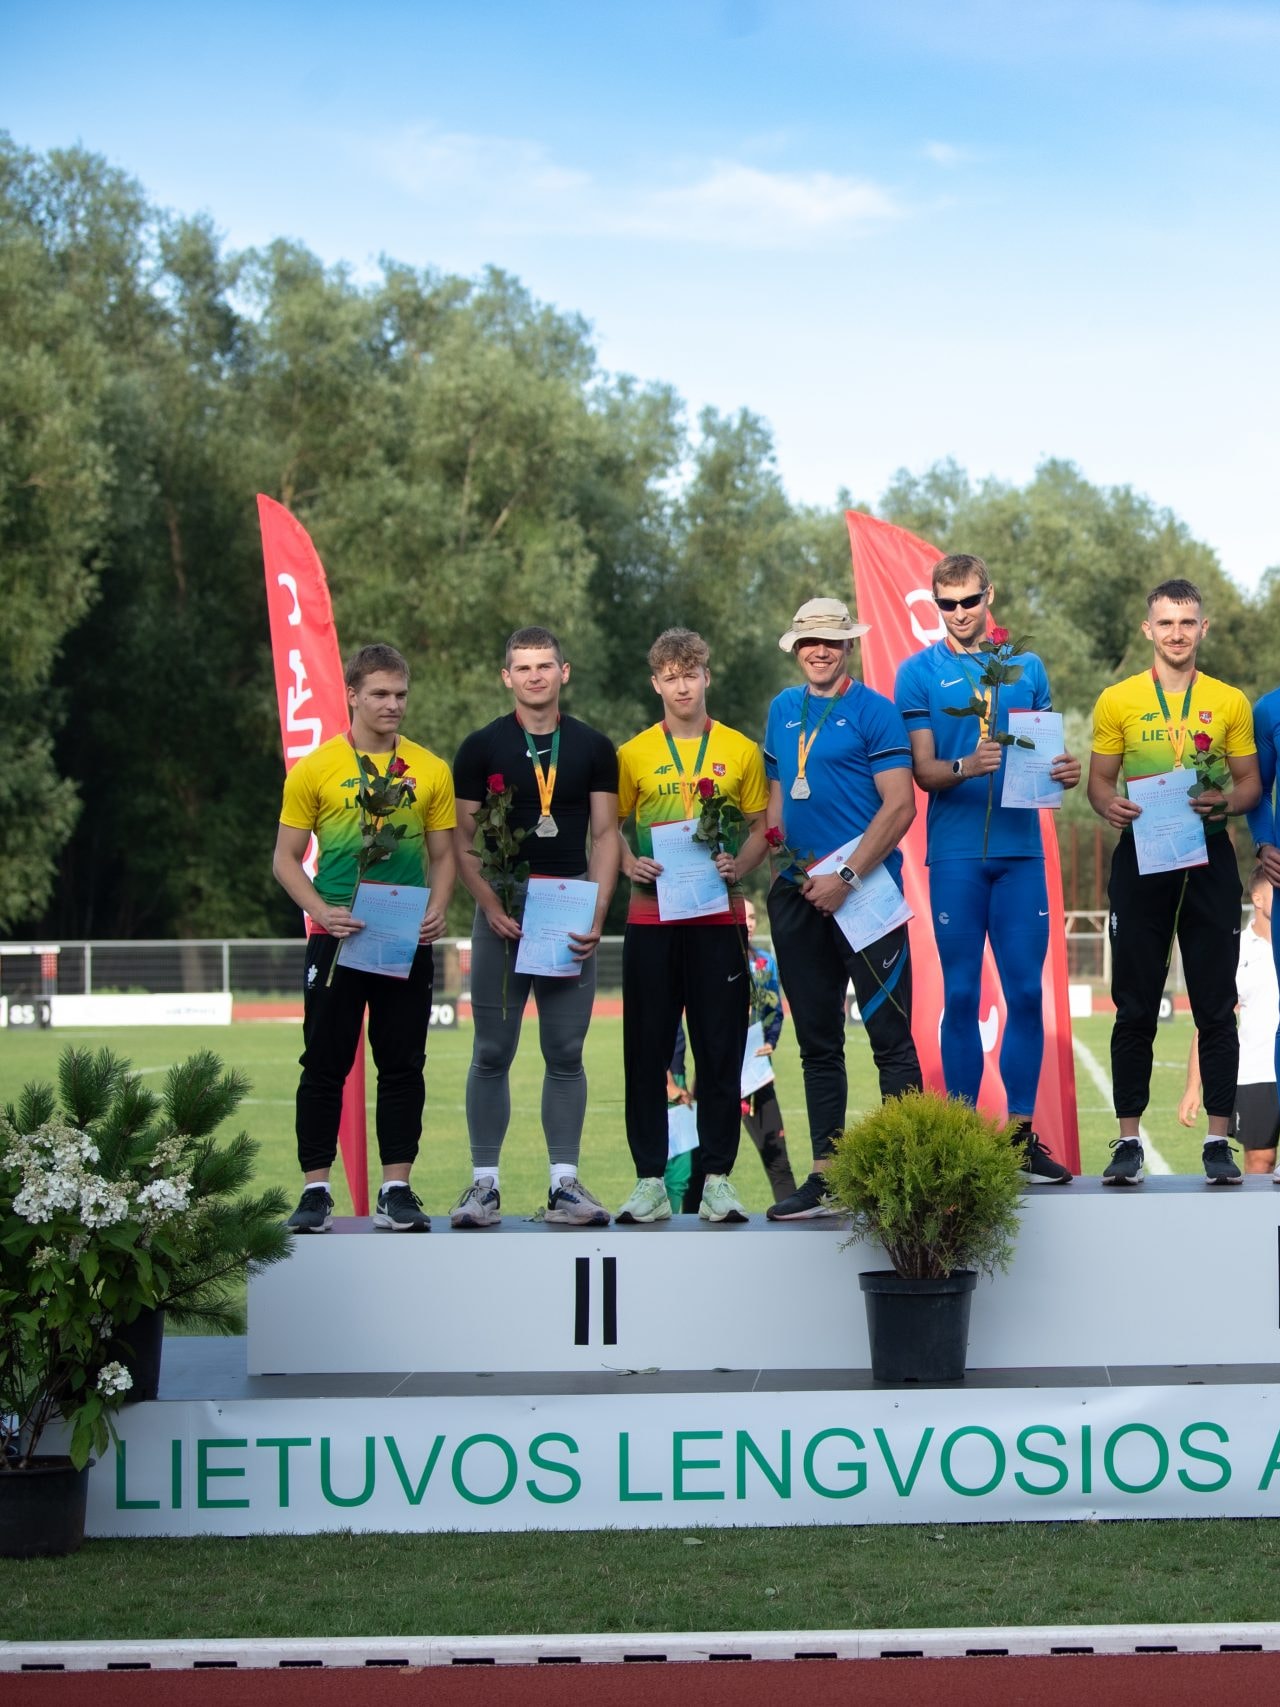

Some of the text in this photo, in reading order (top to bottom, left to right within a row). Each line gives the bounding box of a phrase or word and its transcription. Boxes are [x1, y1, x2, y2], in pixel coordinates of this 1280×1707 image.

[574, 1257, 618, 1345] II
[115, 1433, 581, 1510] LIETUVOS
[619, 1422, 1233, 1503] LENGVOSIOS
